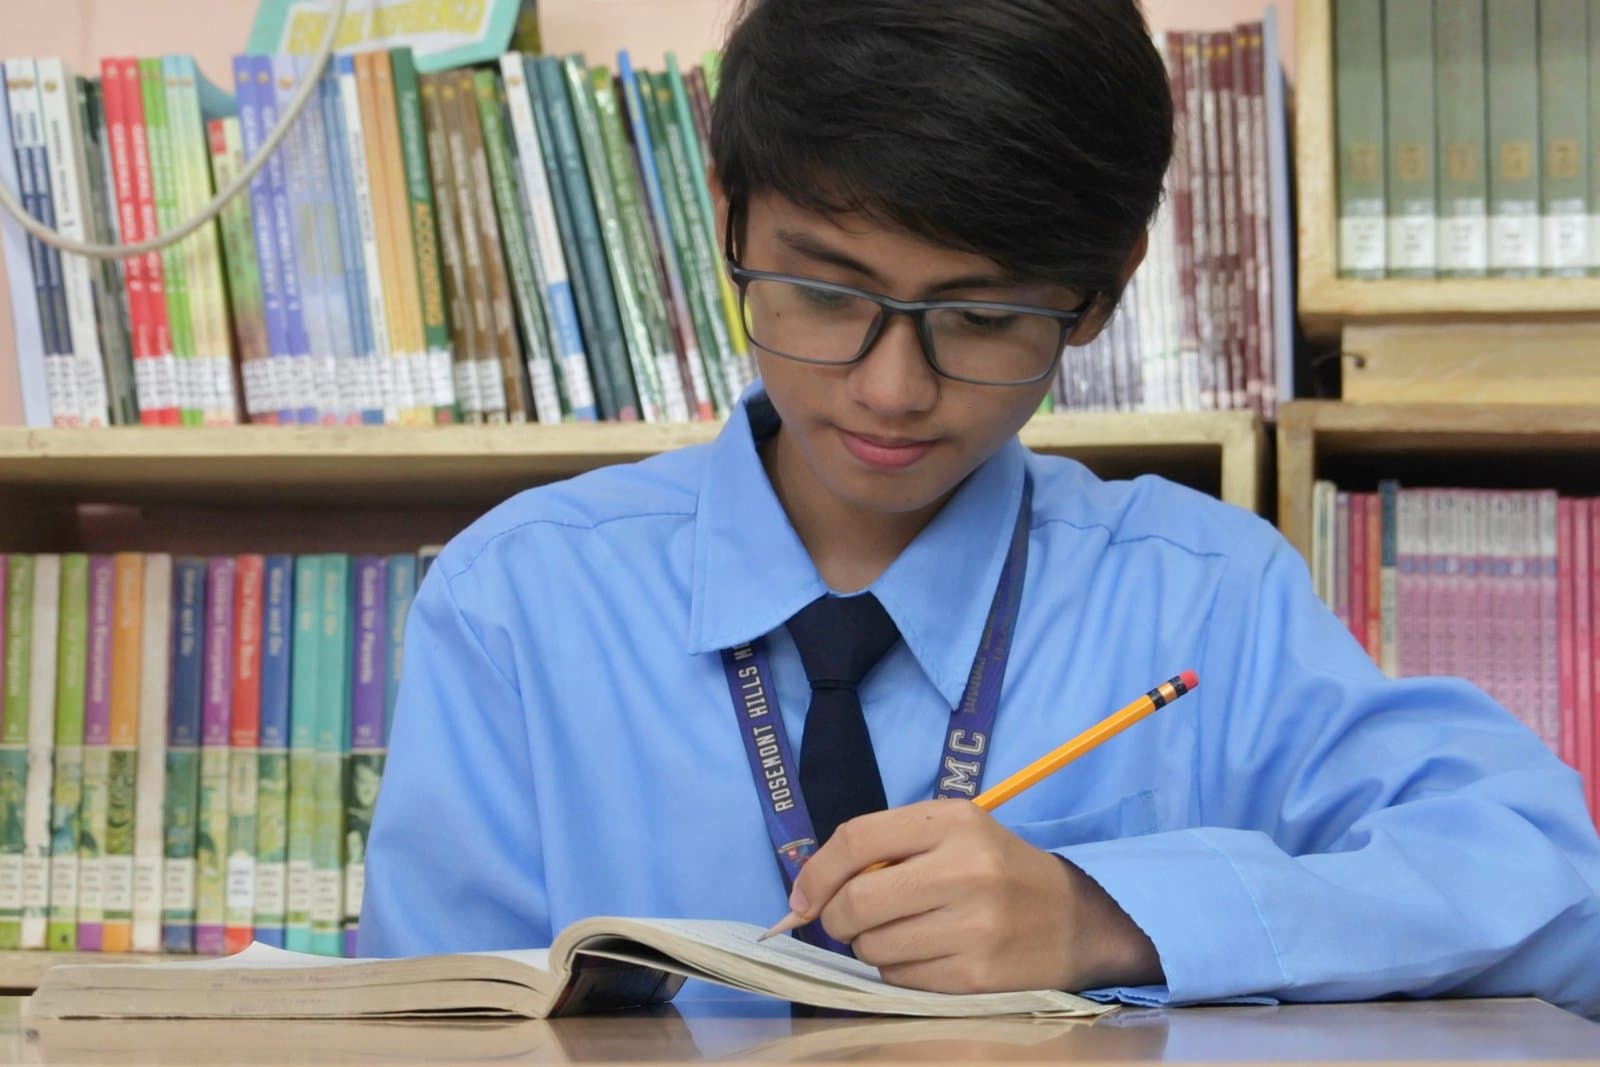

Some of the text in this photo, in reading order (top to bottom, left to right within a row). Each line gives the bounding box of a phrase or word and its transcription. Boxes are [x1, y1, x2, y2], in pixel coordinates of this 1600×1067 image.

[410, 200, 445, 326] ACCOUNTING
[738, 665, 769, 718] HILLS
[753, 724, 794, 813] ROSEMONT
